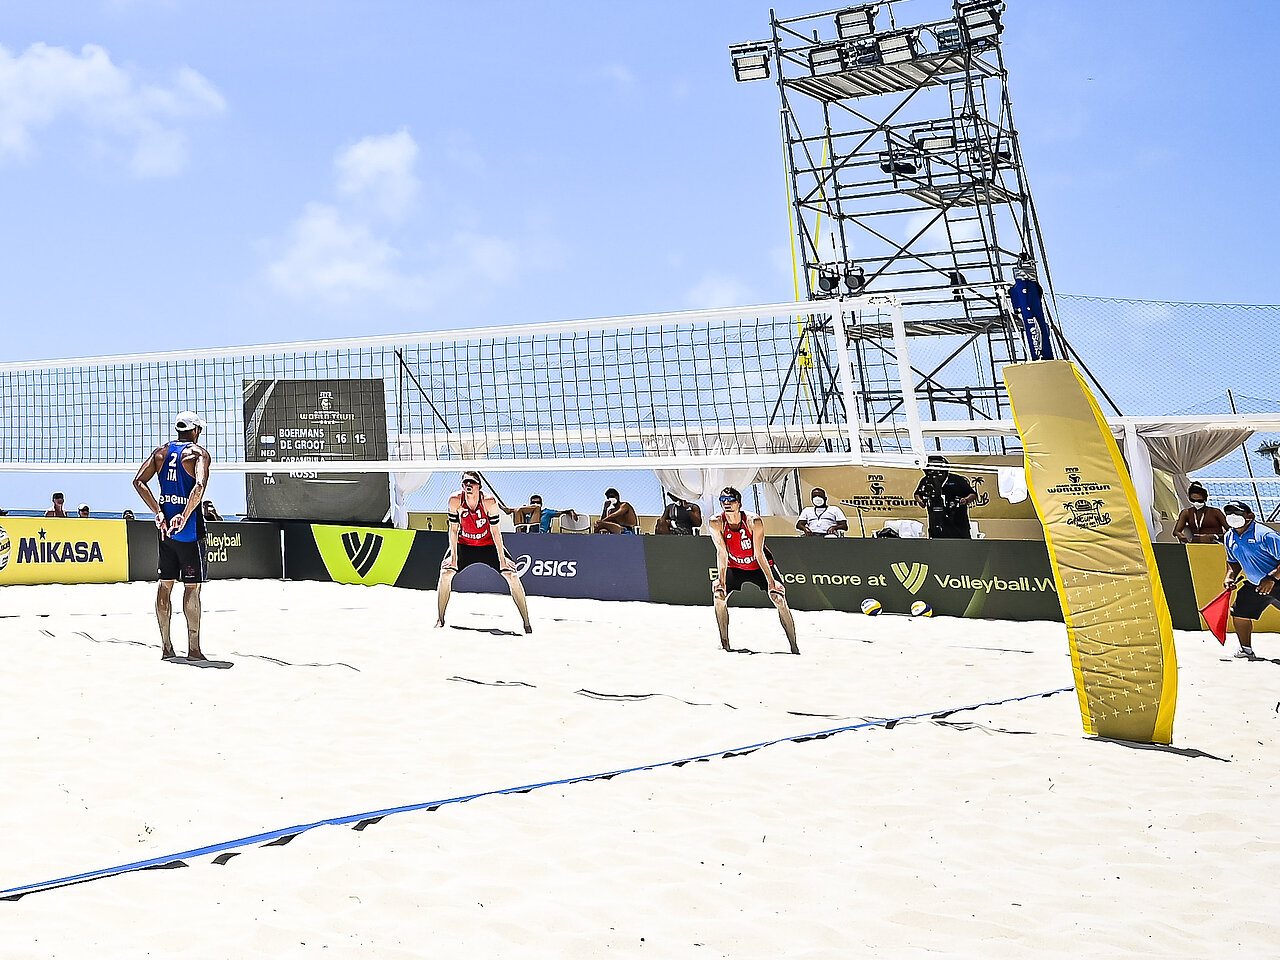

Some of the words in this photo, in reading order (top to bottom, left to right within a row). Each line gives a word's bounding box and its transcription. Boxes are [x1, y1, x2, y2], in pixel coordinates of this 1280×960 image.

[279, 428, 325, 438] BOERMANS
[335, 433, 347, 444] 16
[354, 433, 367, 444] 15
[280, 440, 293, 450] DE
[294, 440, 325, 450] GROOT
[260, 449, 276, 457] NED
[168, 452, 178, 467] 2
[167, 469, 177, 481] ITA
[263, 476, 276, 485] ITA
[739, 528, 748, 539] 2
[206, 532, 241, 550] lleyball
[16, 537, 104, 563] MIKASA
[207, 548, 228, 562] orld
[812, 573, 861, 586] more
[868, 573, 888, 586] at
[933, 574, 1057, 593] Volleyball.W
